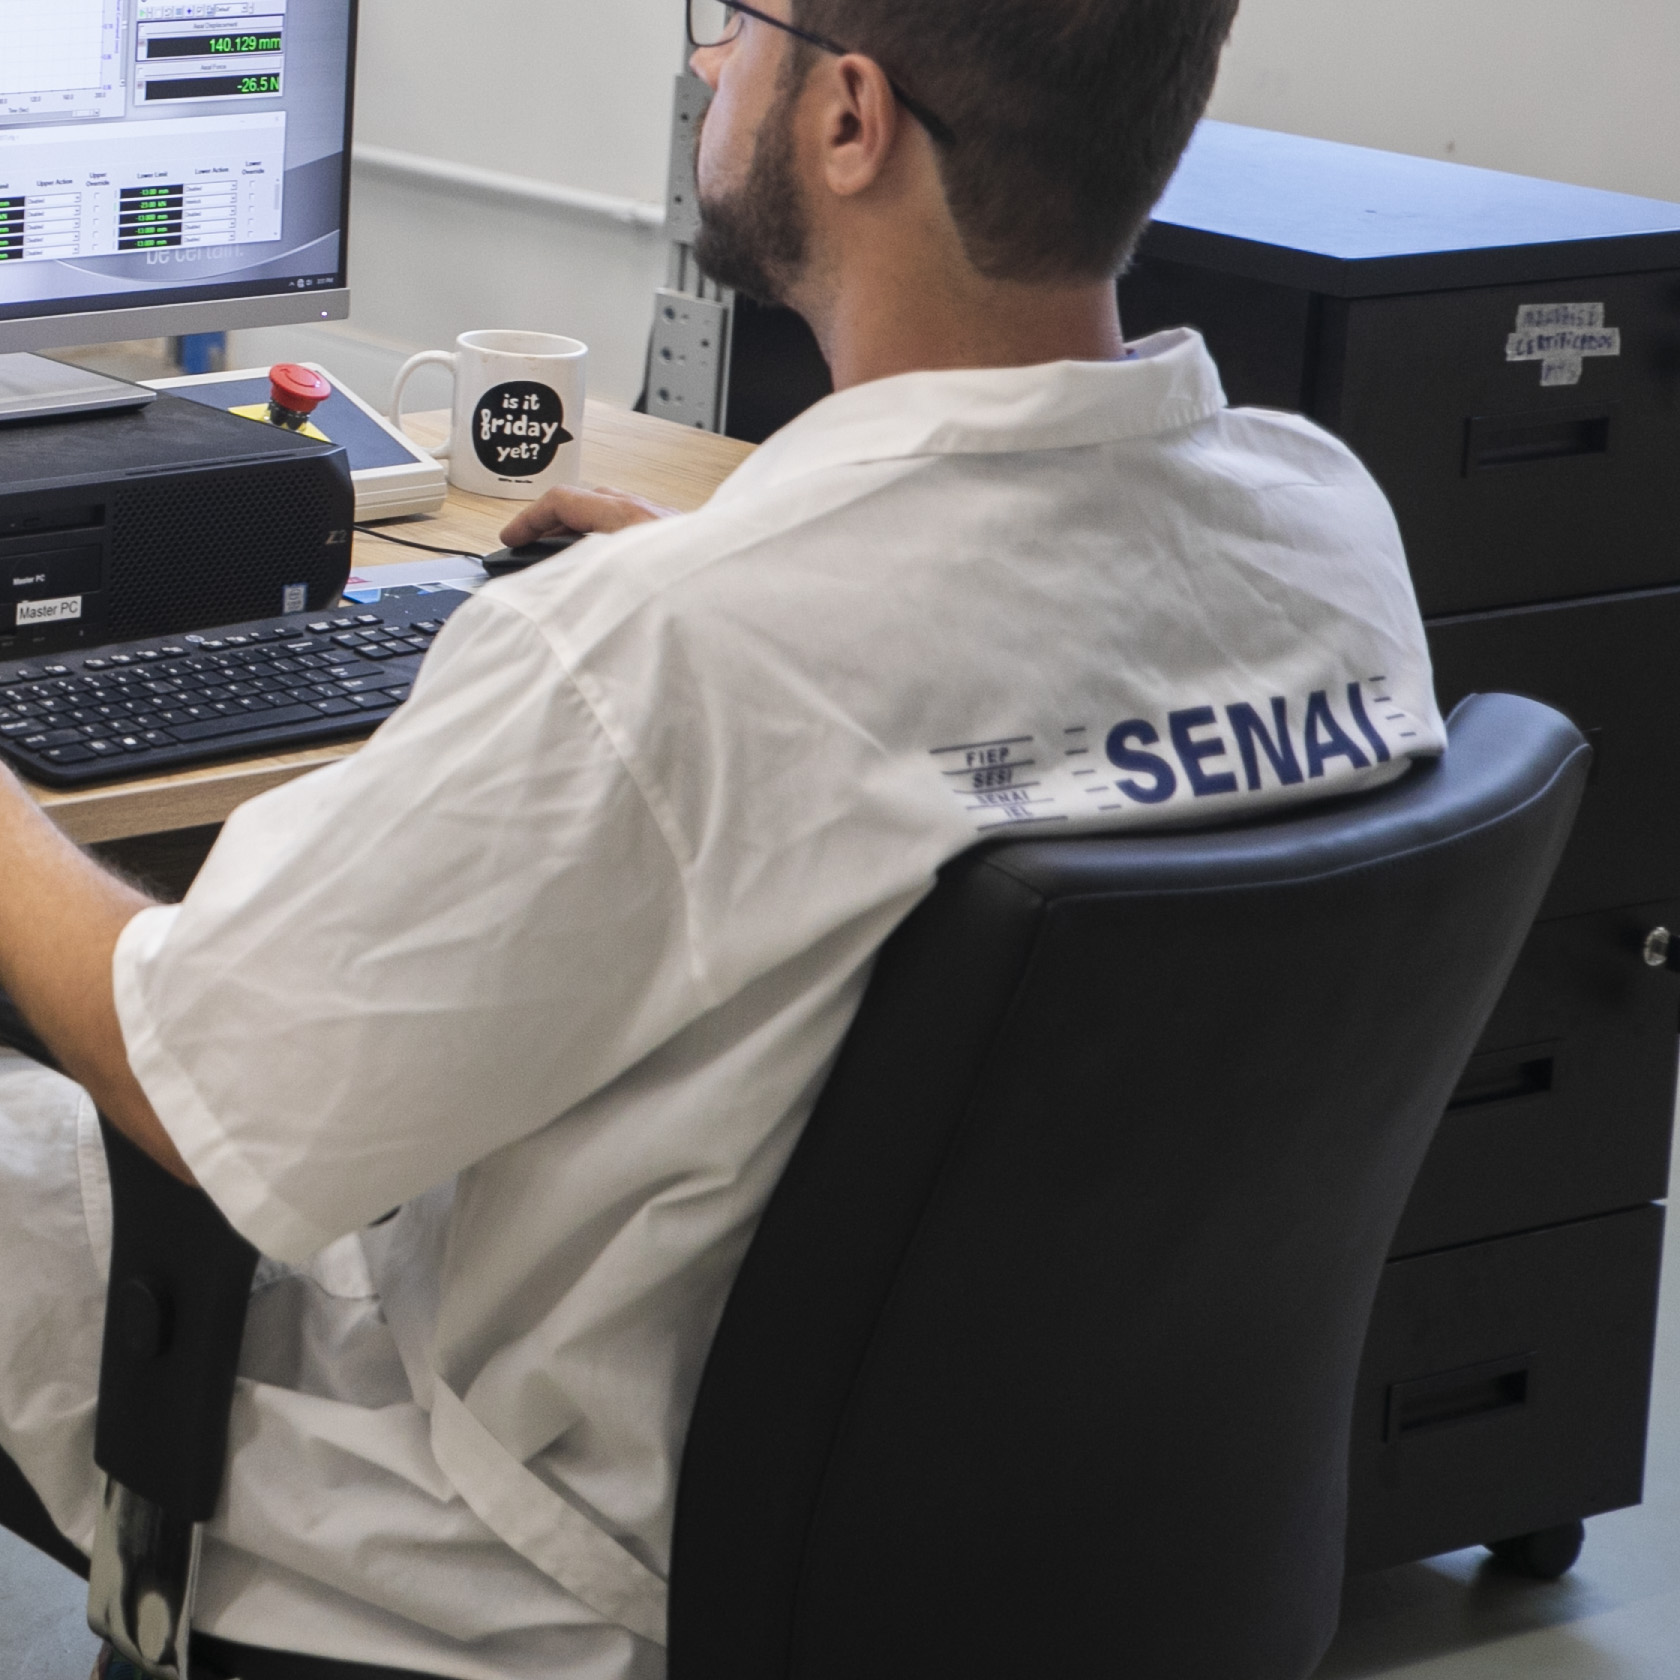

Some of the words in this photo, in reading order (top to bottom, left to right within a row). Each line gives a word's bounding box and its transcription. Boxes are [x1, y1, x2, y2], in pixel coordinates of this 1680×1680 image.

[209, 36, 257, 52] 140.129
[258, 37, 281, 49] mm
[237, 76, 268, 93] -26.5
[269, 76, 280, 90] N
[501, 393, 519, 410] is
[522, 393, 541, 411] it
[480, 408, 559, 444] friday
[496, 441, 541, 463] yet?
[12, 576, 35, 586] Master
[35, 574, 46, 583] PC
[19, 605, 58, 620] Master
[59, 600, 79, 615] PC
[1105, 681, 1391, 805] SENAI
[965, 746, 1009, 767] FIEP
[971, 767, 1013, 788] SESI
